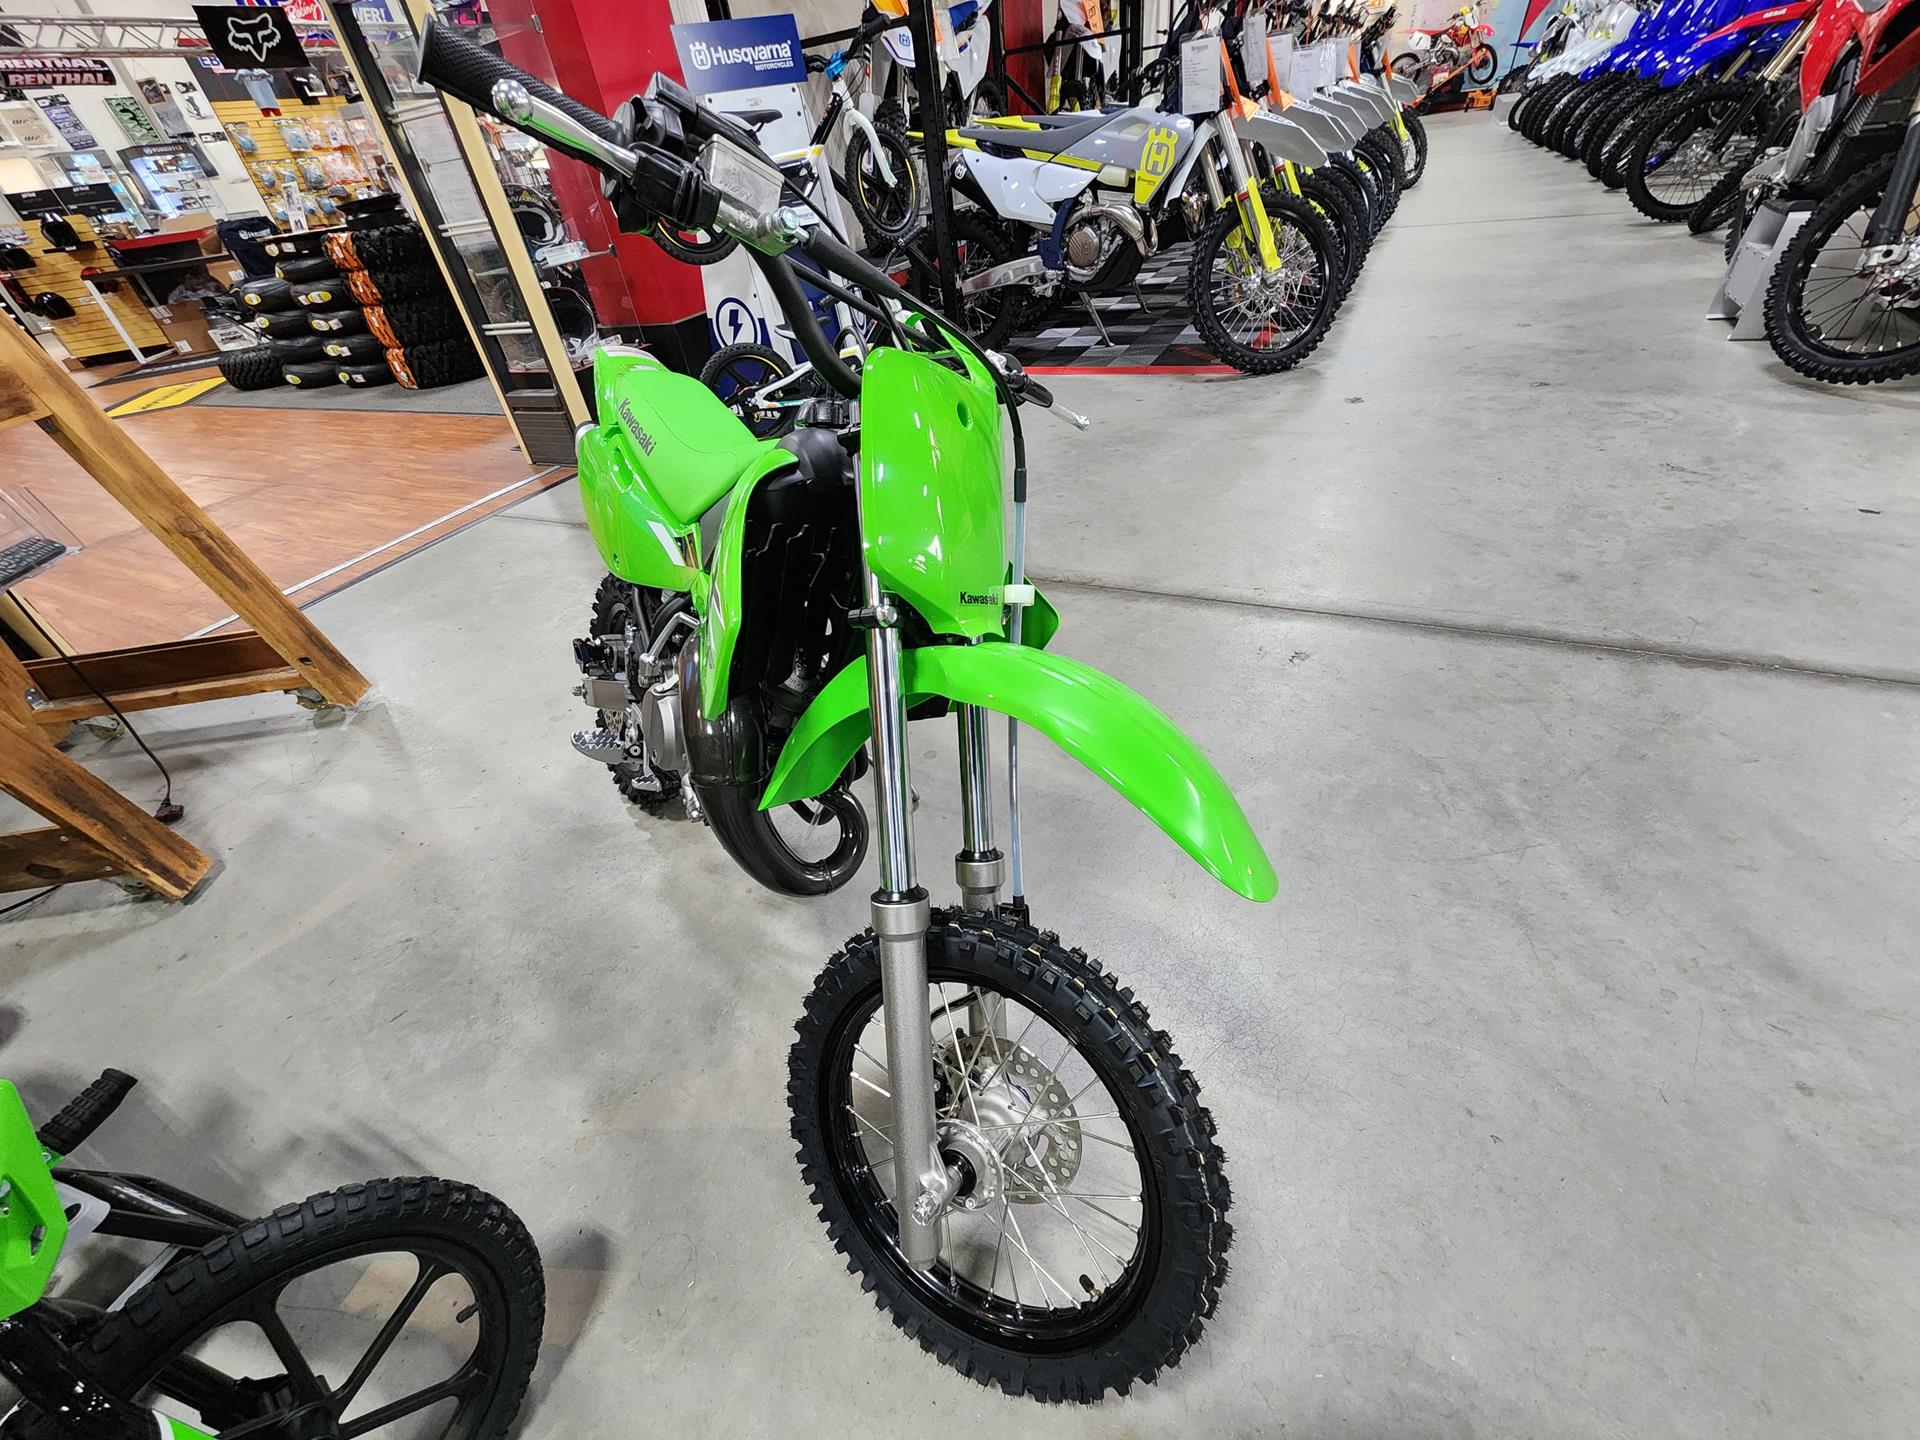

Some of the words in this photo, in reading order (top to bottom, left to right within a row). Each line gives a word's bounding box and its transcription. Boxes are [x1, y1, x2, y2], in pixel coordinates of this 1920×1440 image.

[710, 43, 792, 65] Husqvarna
[754, 61, 794, 71] MOTORCYCLES
[8, 73, 110, 85] RENTHAL
[619, 398, 657, 456] Kawasaki
[960, 591, 999, 606] Kawasaki
